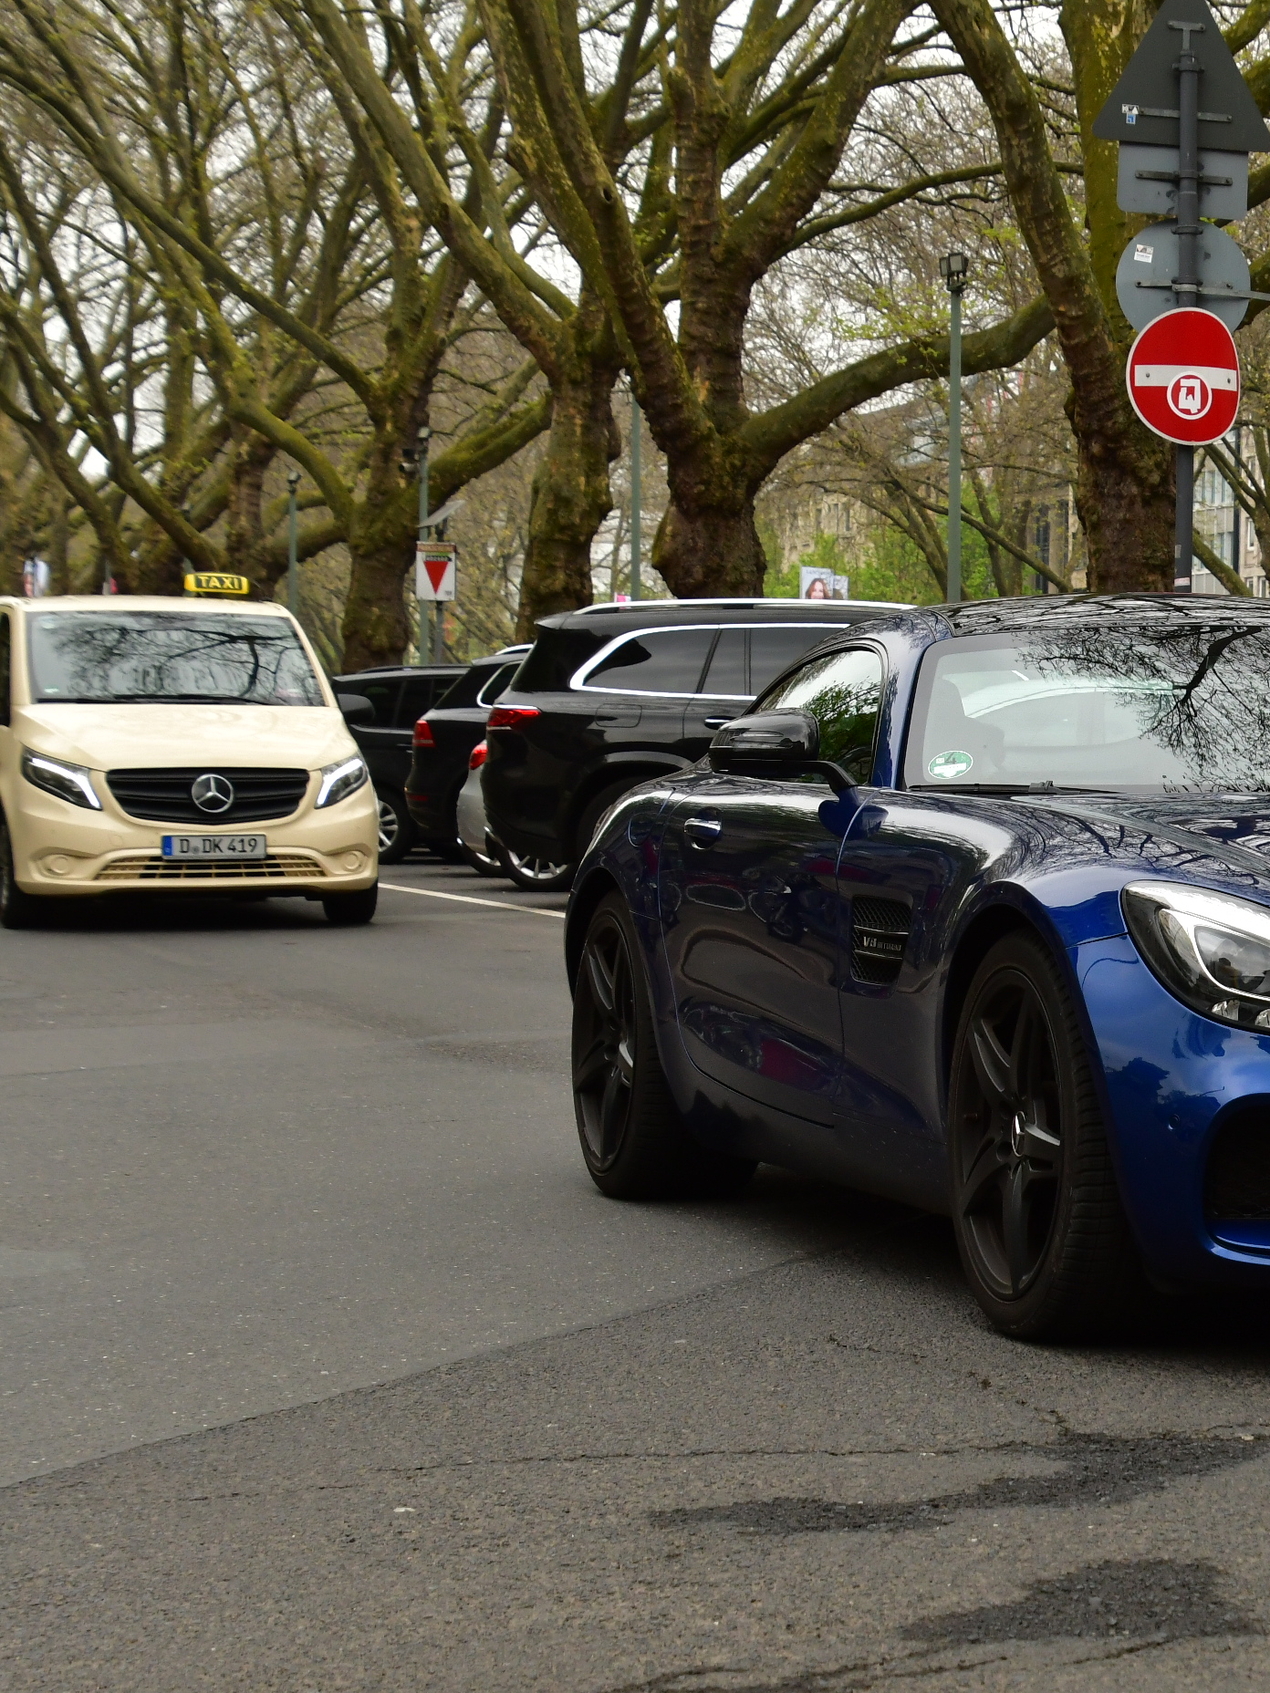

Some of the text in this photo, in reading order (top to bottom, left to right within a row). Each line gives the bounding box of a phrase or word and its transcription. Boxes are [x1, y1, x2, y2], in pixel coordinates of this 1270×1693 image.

[197, 575, 240, 590] TAXI
[179, 837, 258, 854] D DK 419
